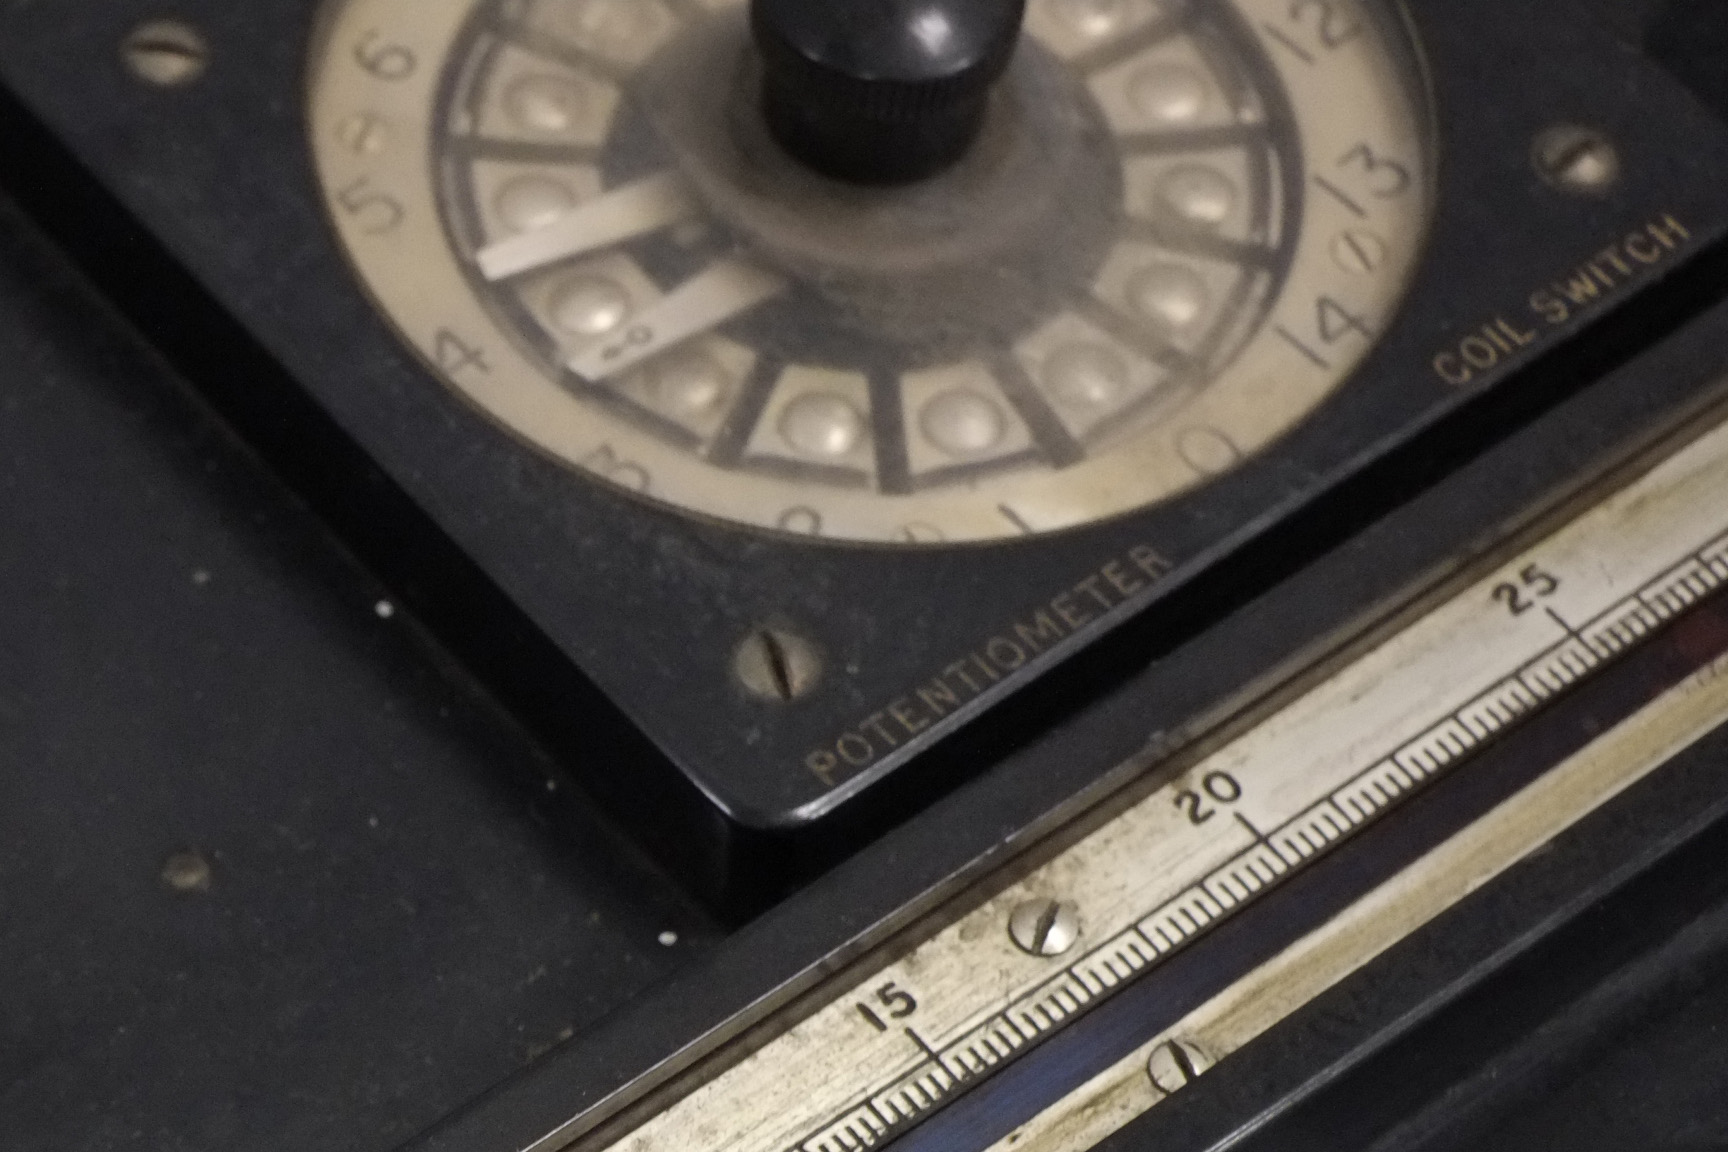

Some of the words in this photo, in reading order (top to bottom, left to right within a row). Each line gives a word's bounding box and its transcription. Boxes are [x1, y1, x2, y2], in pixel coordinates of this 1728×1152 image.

[355, 27, 418, 82] 6
[1313, 143, 1412, 219] 13
[1274, 294, 1374, 369] 14
[1432, 322, 1532, 387] COIL
[1529, 214, 1691, 323] SWITCH
[1491, 563, 1559, 614] 25
[806, 543, 1172, 783] POTENTIOMETER
[1173, 768, 1244, 824] 20
[855, 980, 918, 1031] 15
